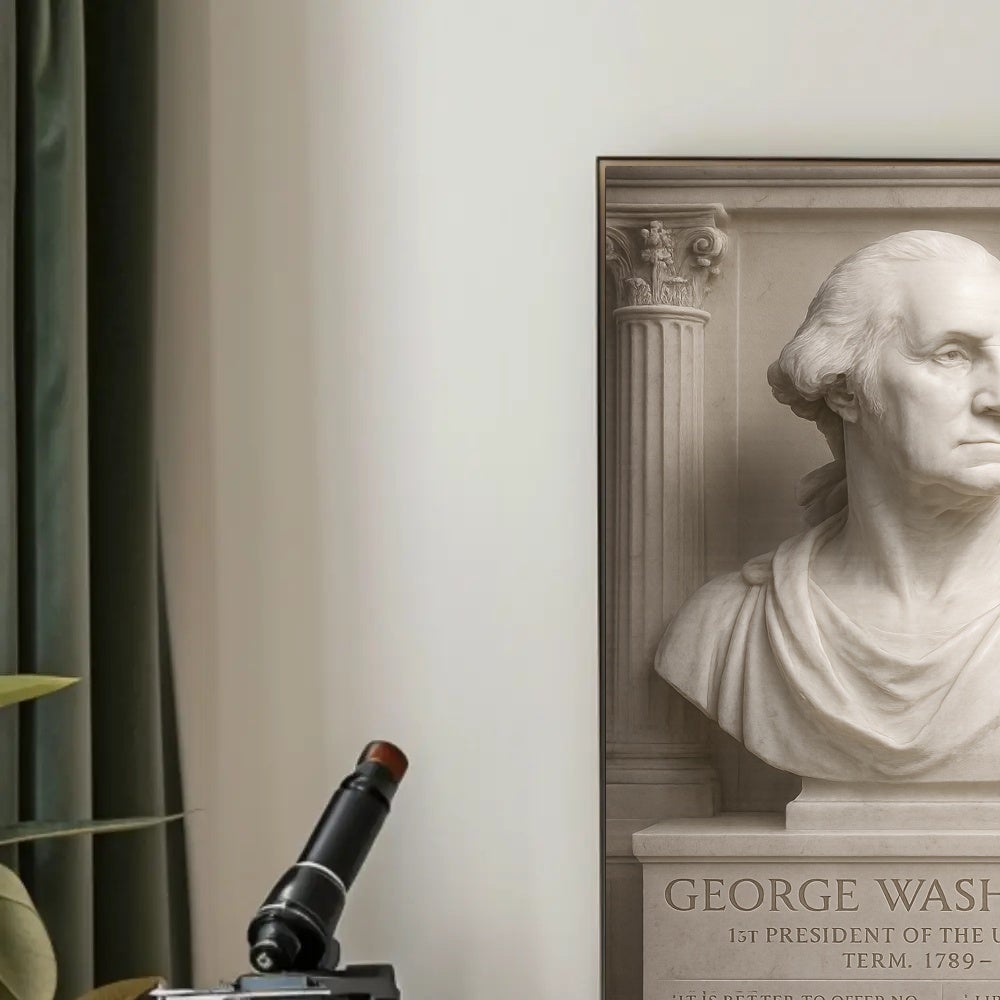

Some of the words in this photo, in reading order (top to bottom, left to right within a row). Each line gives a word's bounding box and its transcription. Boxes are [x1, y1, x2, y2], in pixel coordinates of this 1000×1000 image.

[664, 878, 860, 912] GEORGE
[766, 927, 895, 944] PRESIDENT
[903, 927, 932, 944] OF
[940, 927, 984, 944] THE
[842, 953, 913, 969] TERM.
